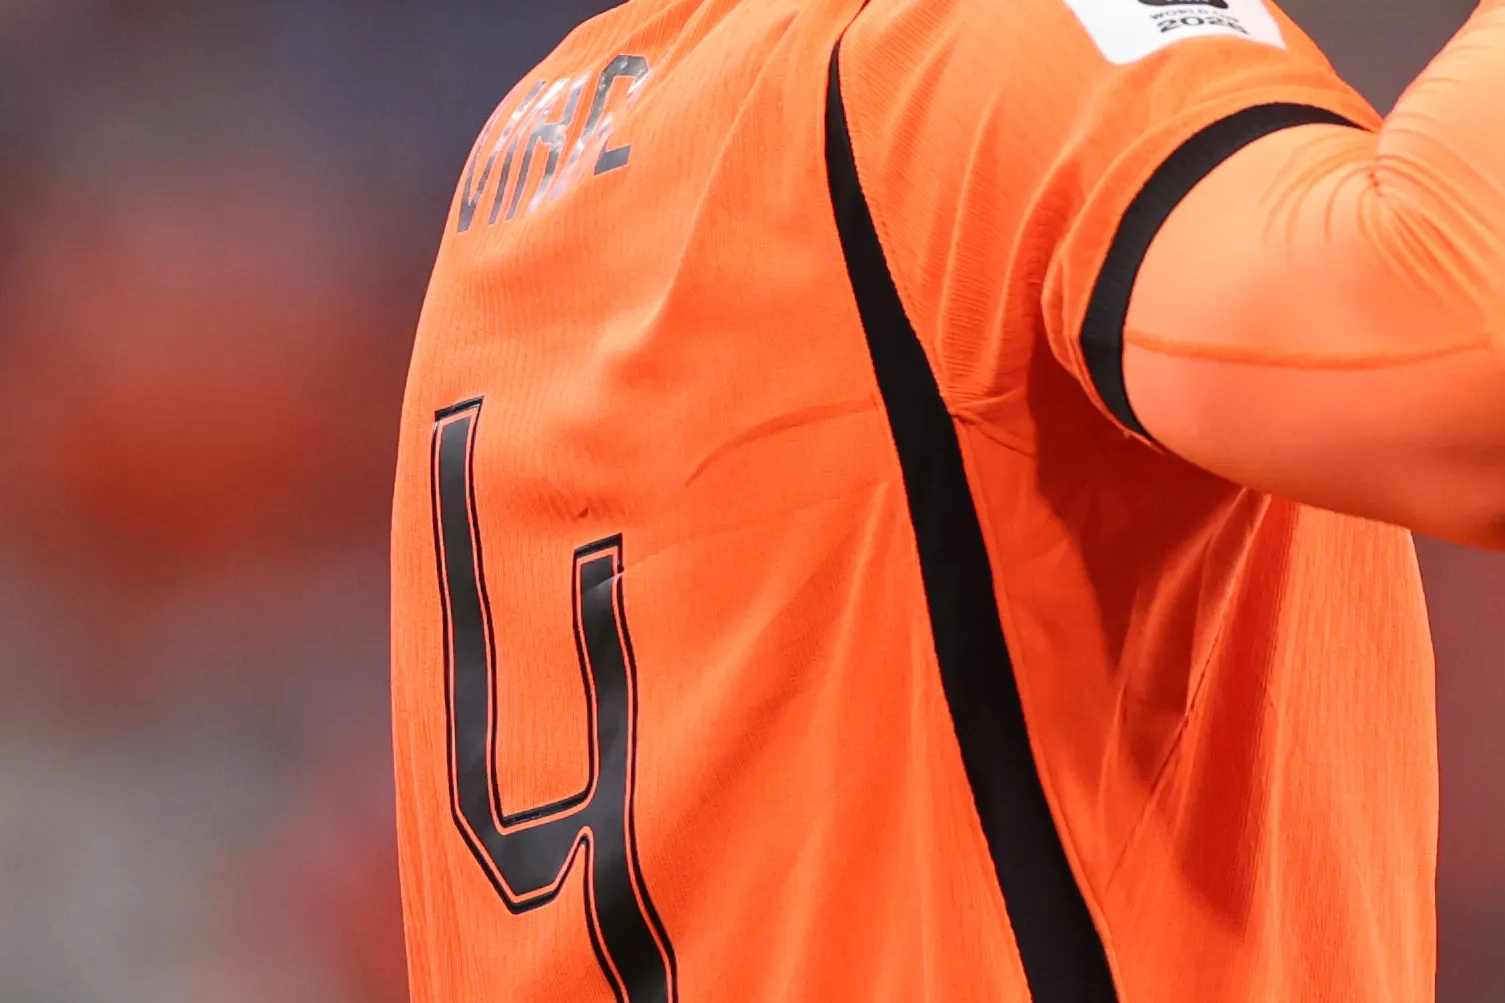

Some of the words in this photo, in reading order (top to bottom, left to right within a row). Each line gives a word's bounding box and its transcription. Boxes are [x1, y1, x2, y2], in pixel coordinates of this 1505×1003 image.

[1150, 8, 1208, 20] WORLD
[1157, 16, 1249, 35] 2026
[430, 395, 680, 1003] 4
